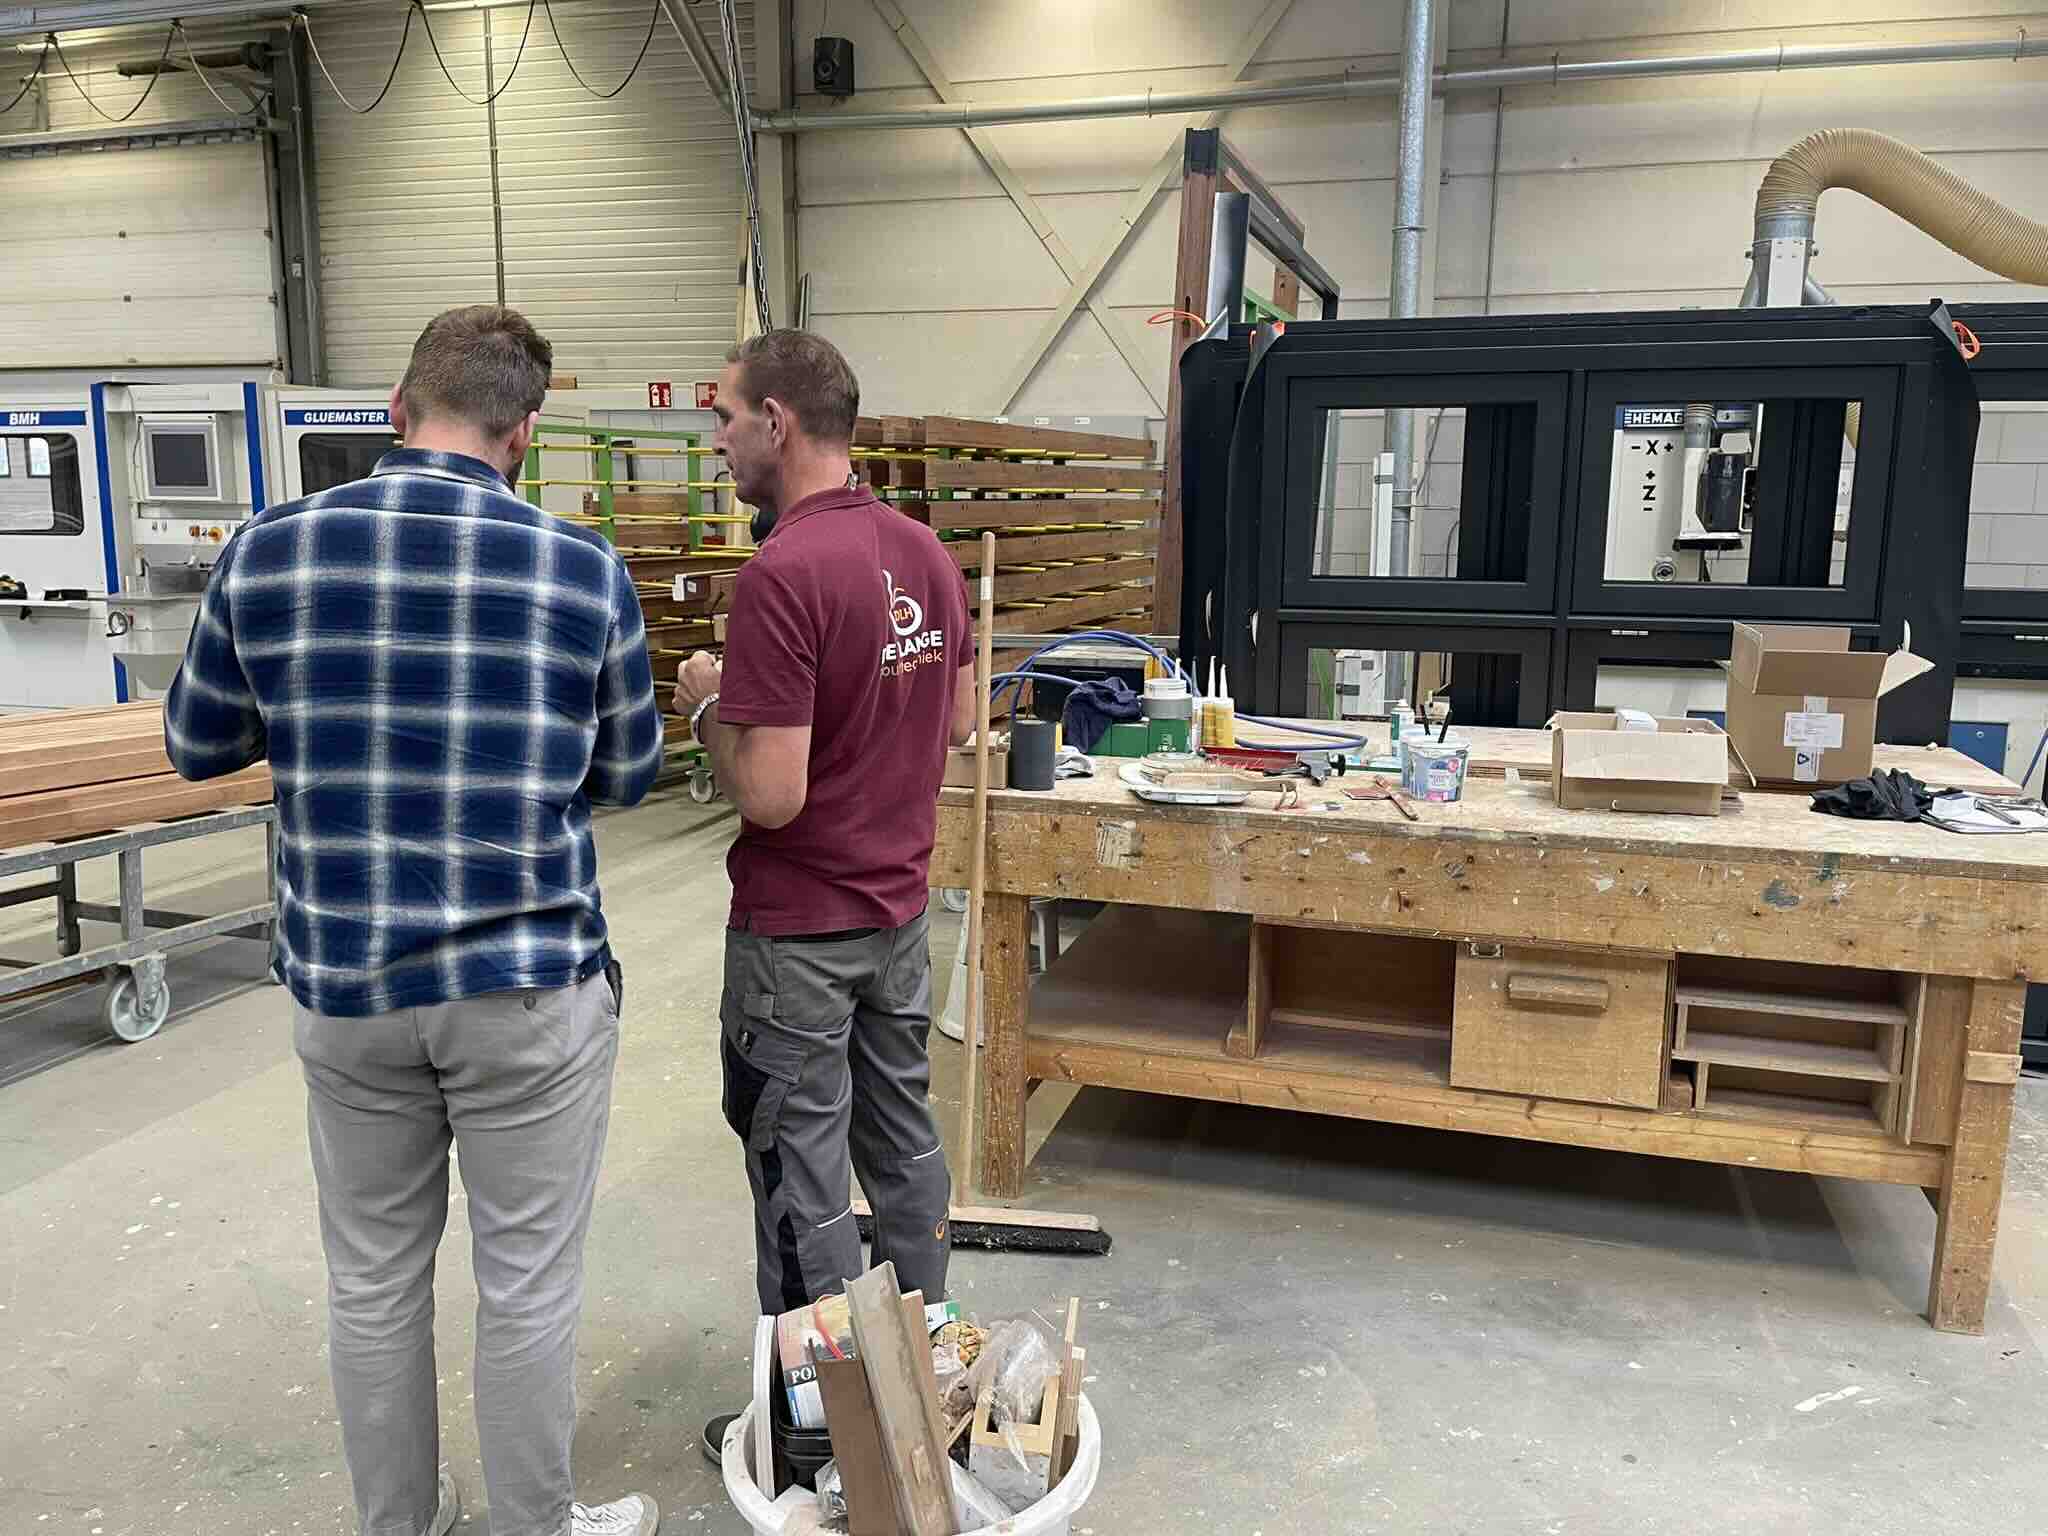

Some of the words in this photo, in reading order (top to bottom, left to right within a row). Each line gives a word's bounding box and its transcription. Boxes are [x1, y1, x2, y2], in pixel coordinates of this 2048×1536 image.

[9, 412, 40, 425] BMH
[303, 411, 385, 423] GLUEMASTER
[894, 606, 914, 621] DLH
